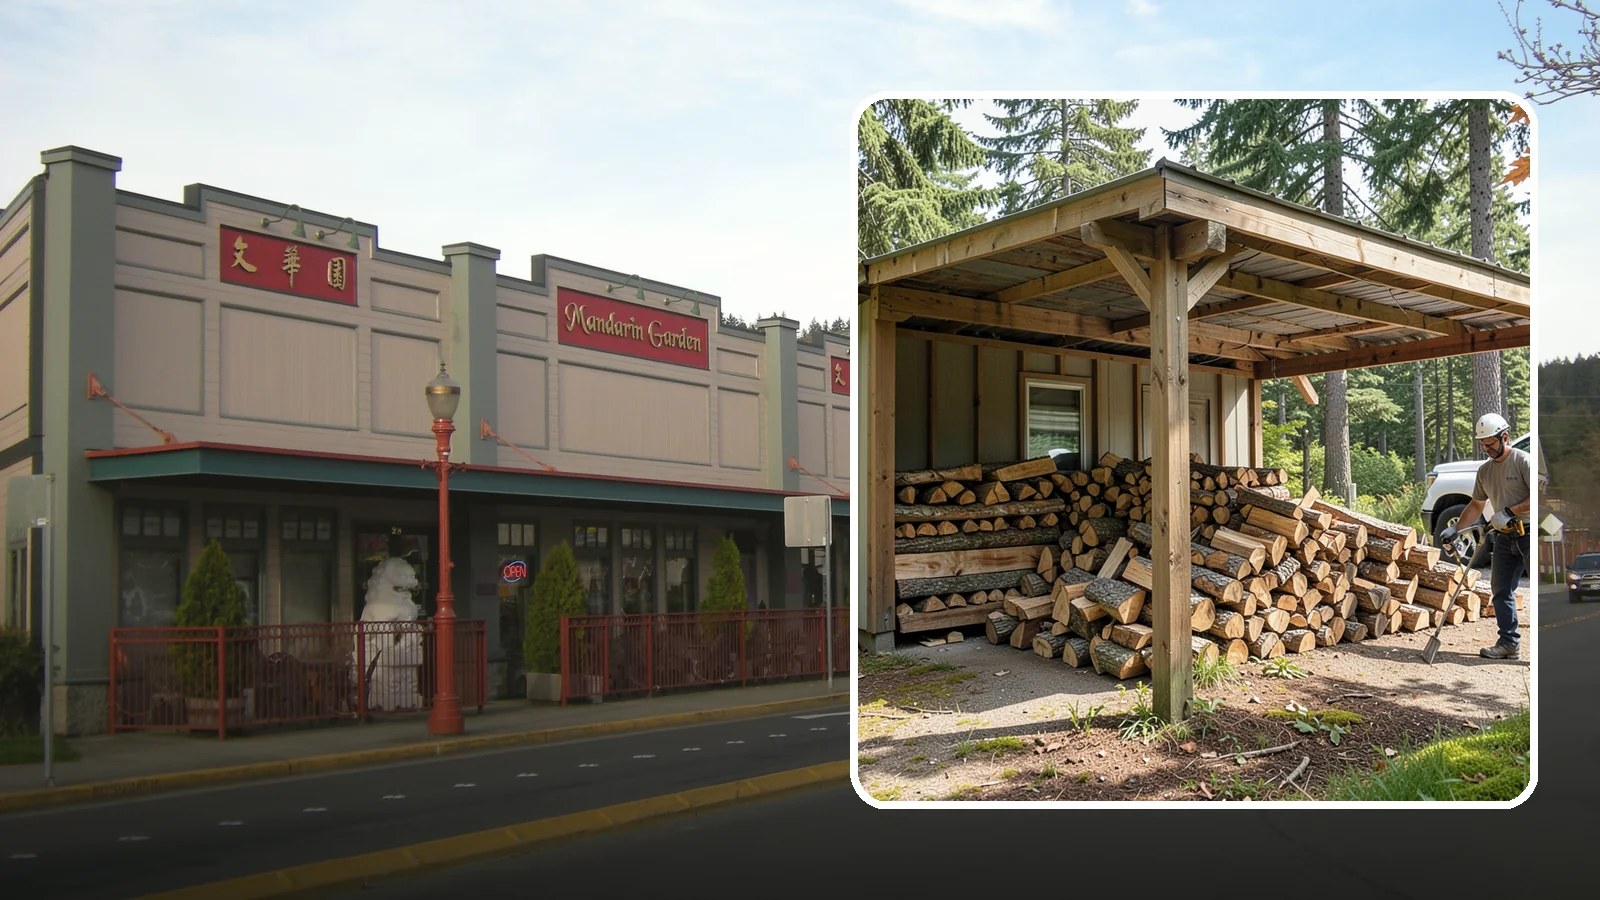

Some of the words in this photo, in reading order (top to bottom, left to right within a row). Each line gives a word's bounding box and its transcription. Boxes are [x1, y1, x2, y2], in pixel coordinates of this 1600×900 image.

[230, 235, 346, 291] 文華園
[564, 302, 644, 341] Mandarin
[647, 320, 702, 352] Garden
[503, 565, 527, 578] OPEN
